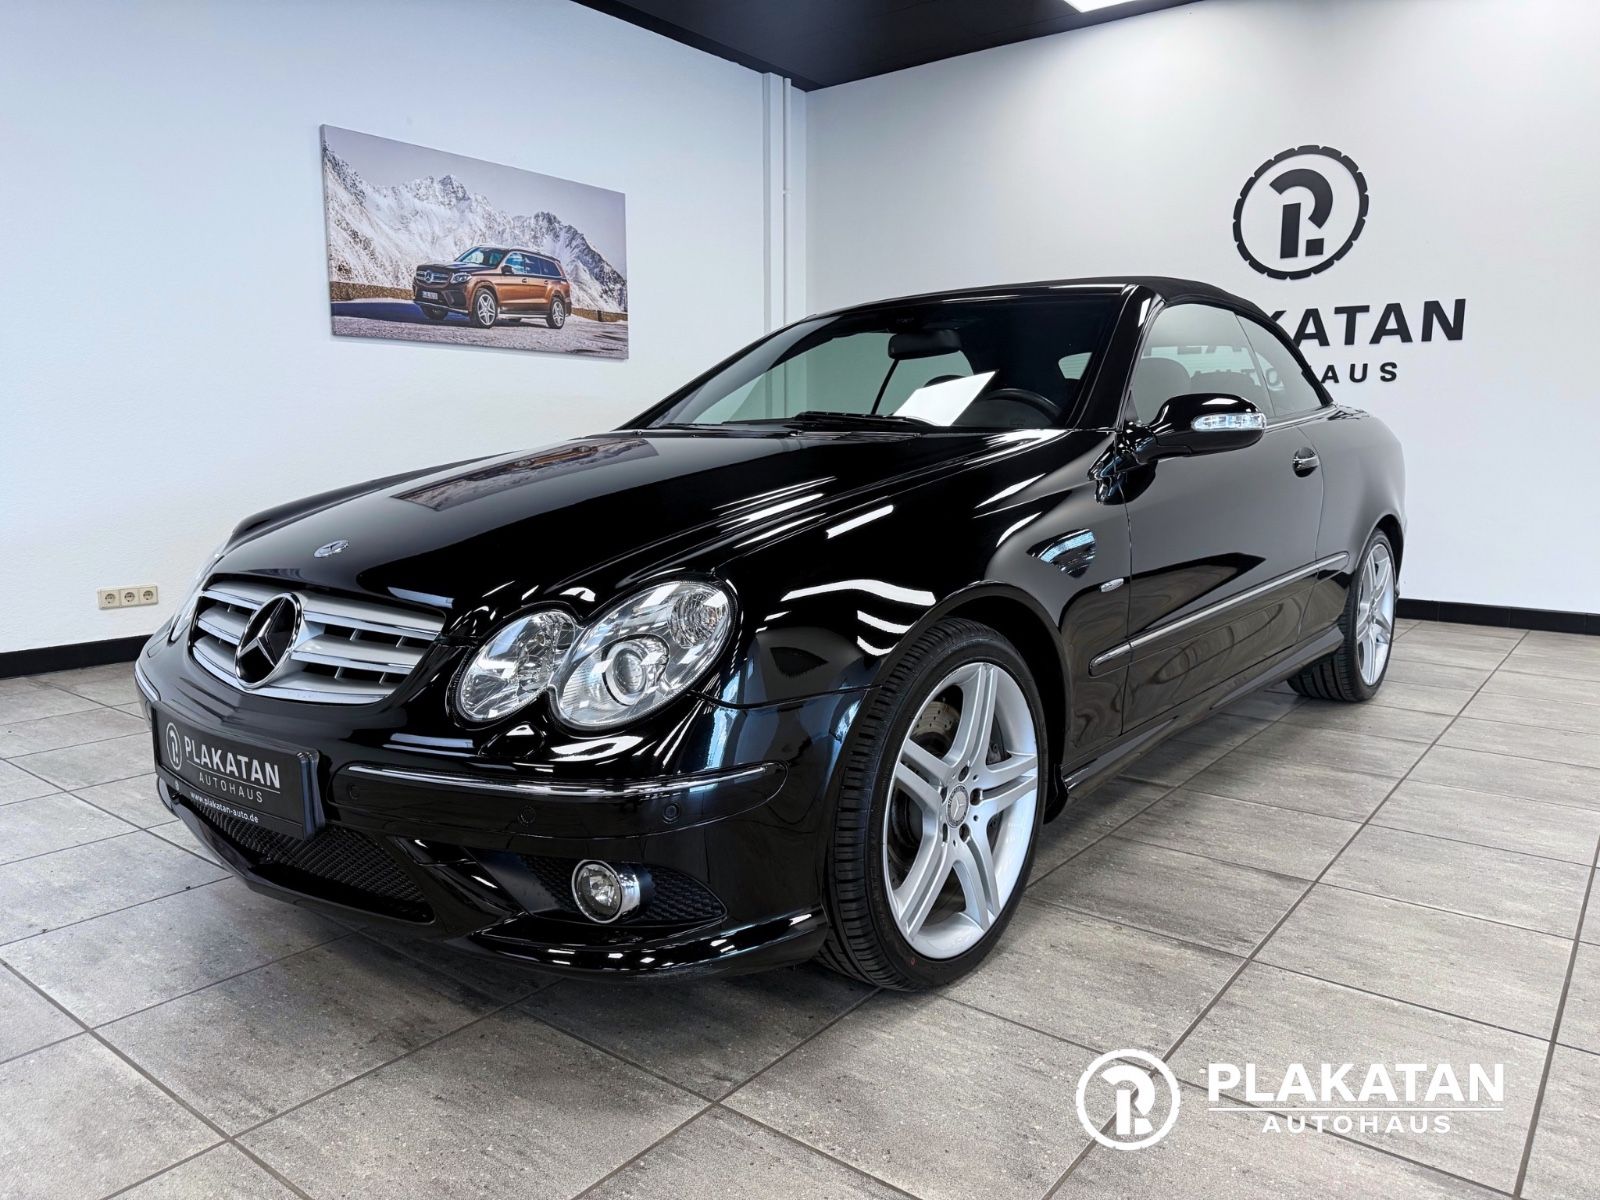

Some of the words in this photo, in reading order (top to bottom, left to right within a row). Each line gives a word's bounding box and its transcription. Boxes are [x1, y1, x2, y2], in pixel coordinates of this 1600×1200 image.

[1268, 298, 1467, 348] ATAN
[184, 735, 280, 789] PLAKATAN
[190, 791, 259, 824] www.plakatan-auto.de
[199, 772, 263, 803] AUTOHAUS
